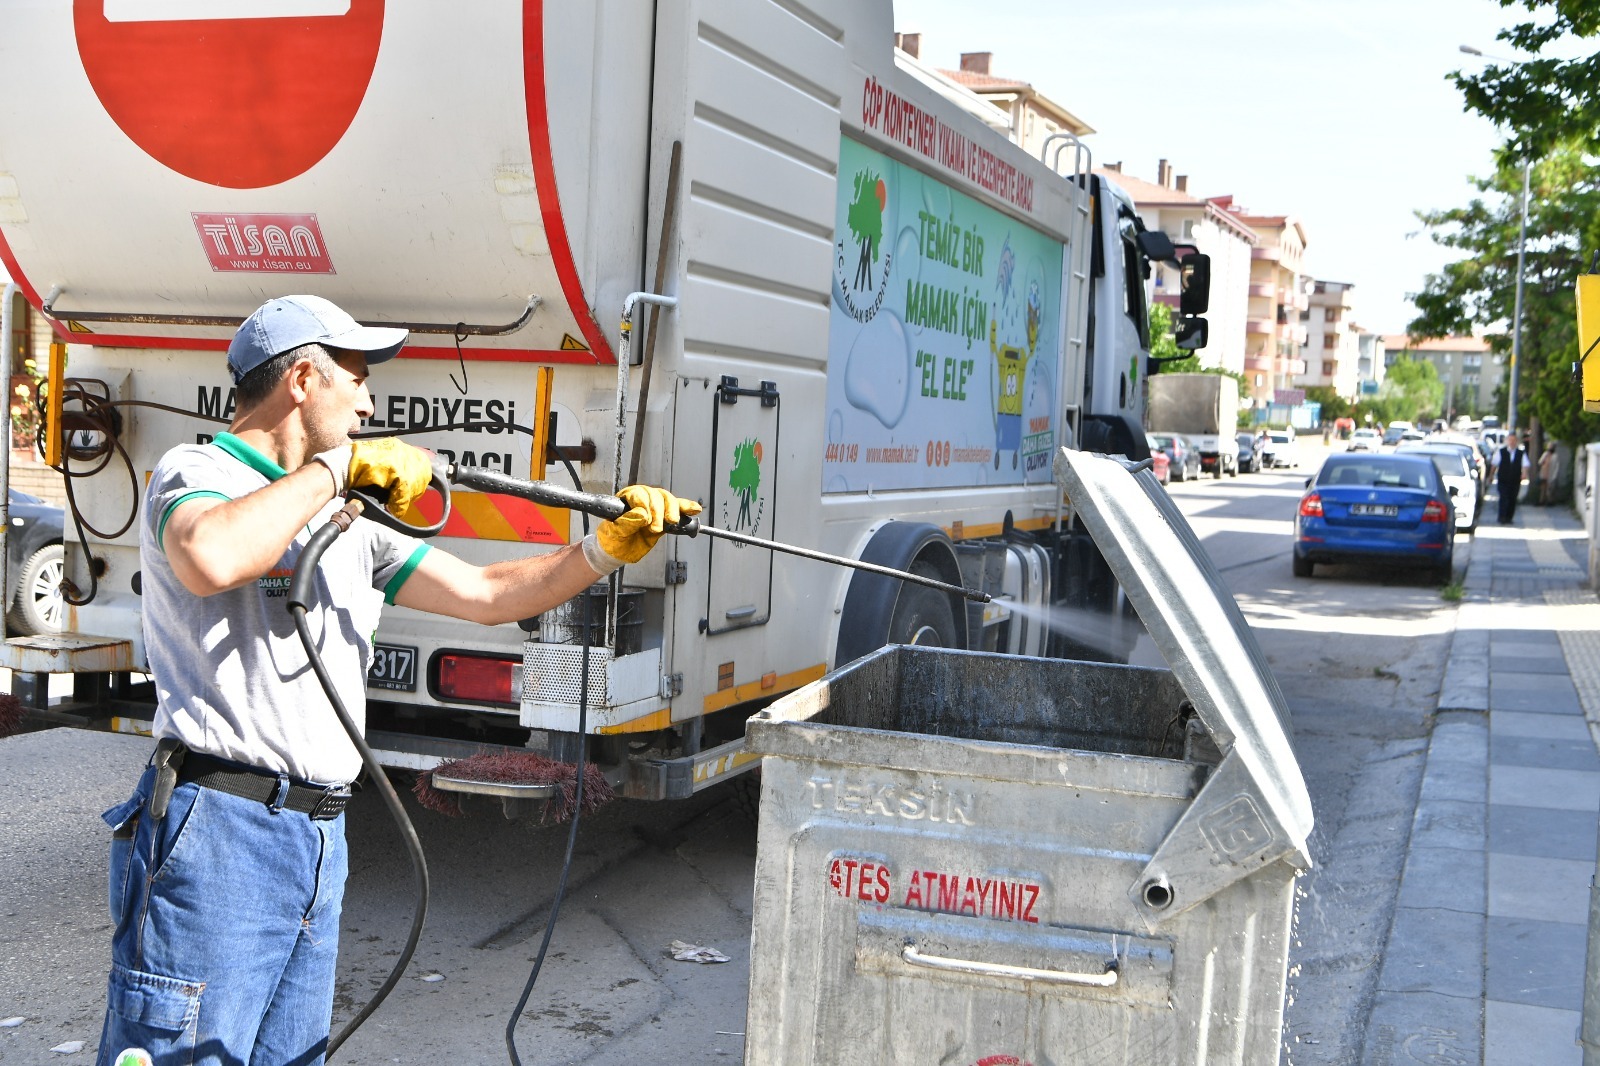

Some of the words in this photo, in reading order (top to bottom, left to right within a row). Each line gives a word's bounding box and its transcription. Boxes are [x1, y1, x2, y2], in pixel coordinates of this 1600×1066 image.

[863, 75, 883, 133] ÇÖP
[939, 121, 965, 176] YIKAMA
[968, 139, 977, 182] VE
[919, 210, 960, 269] TEMİZ
[963, 224, 984, 277] BİR
[841, 278, 863, 324] MAMAK
[905, 279, 959, 335] MAMAK
[962, 285, 987, 350] İÇİN
[825, 443, 839, 463] 444
[846, 443, 859, 462] 149
[266, 588, 289, 598] OLUY
[373, 649, 411, 680] 317
[905, 869, 1040, 924] ATMAYINIZ
